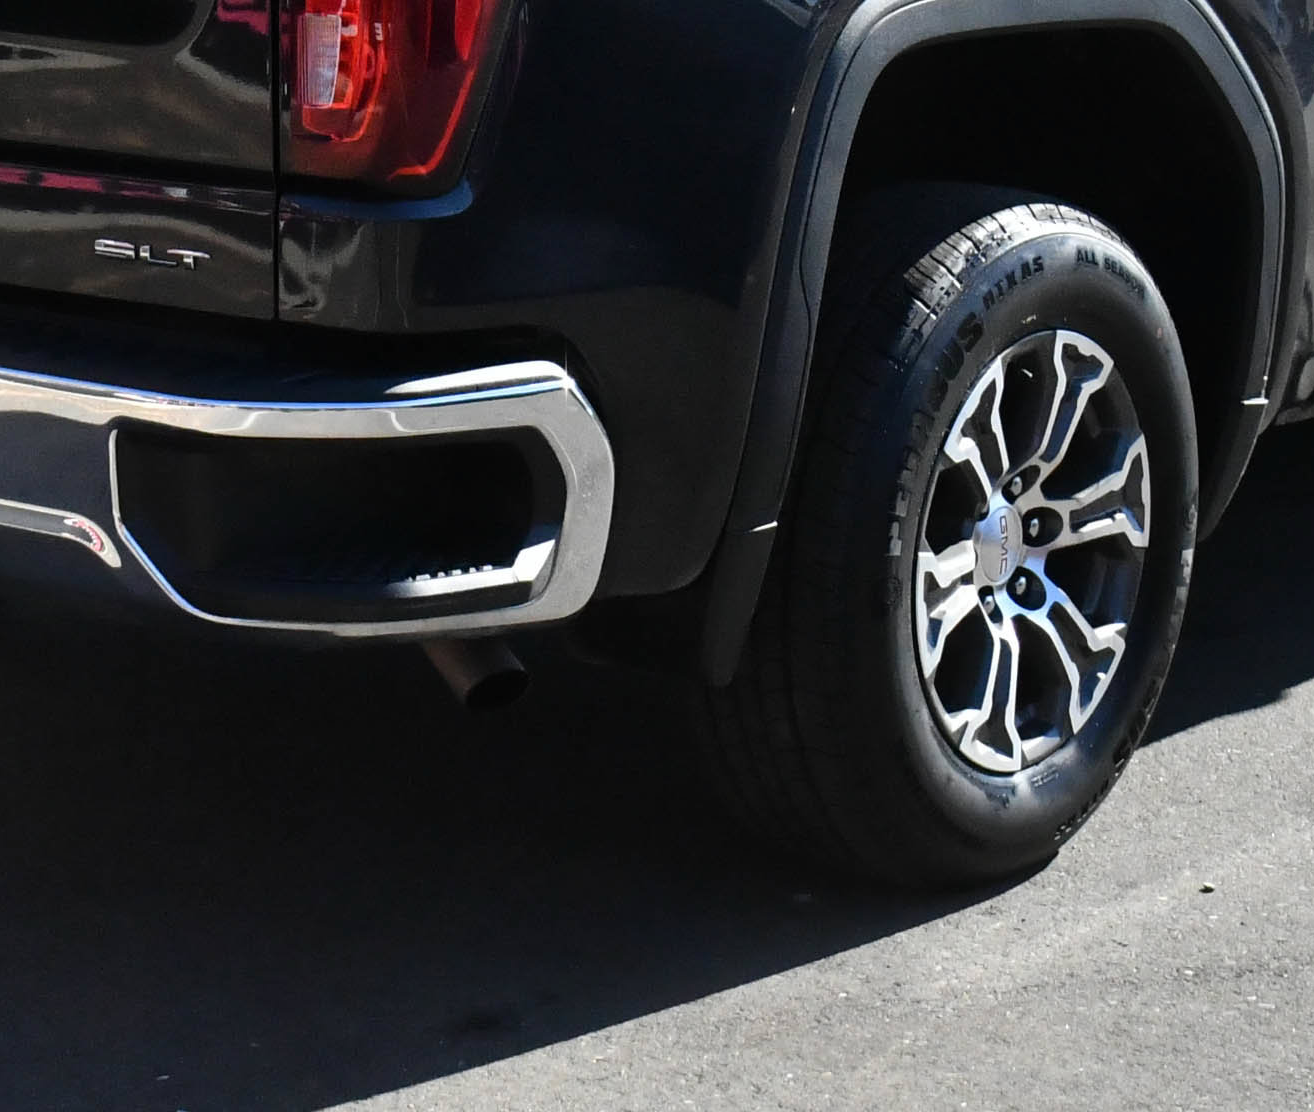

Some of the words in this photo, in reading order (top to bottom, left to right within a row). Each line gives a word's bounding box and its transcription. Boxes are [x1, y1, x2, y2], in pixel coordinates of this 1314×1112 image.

[94, 238, 211, 271] SLT
[1075, 245, 1098, 266] ALL
[999, 515, 1008, 577] GMC
